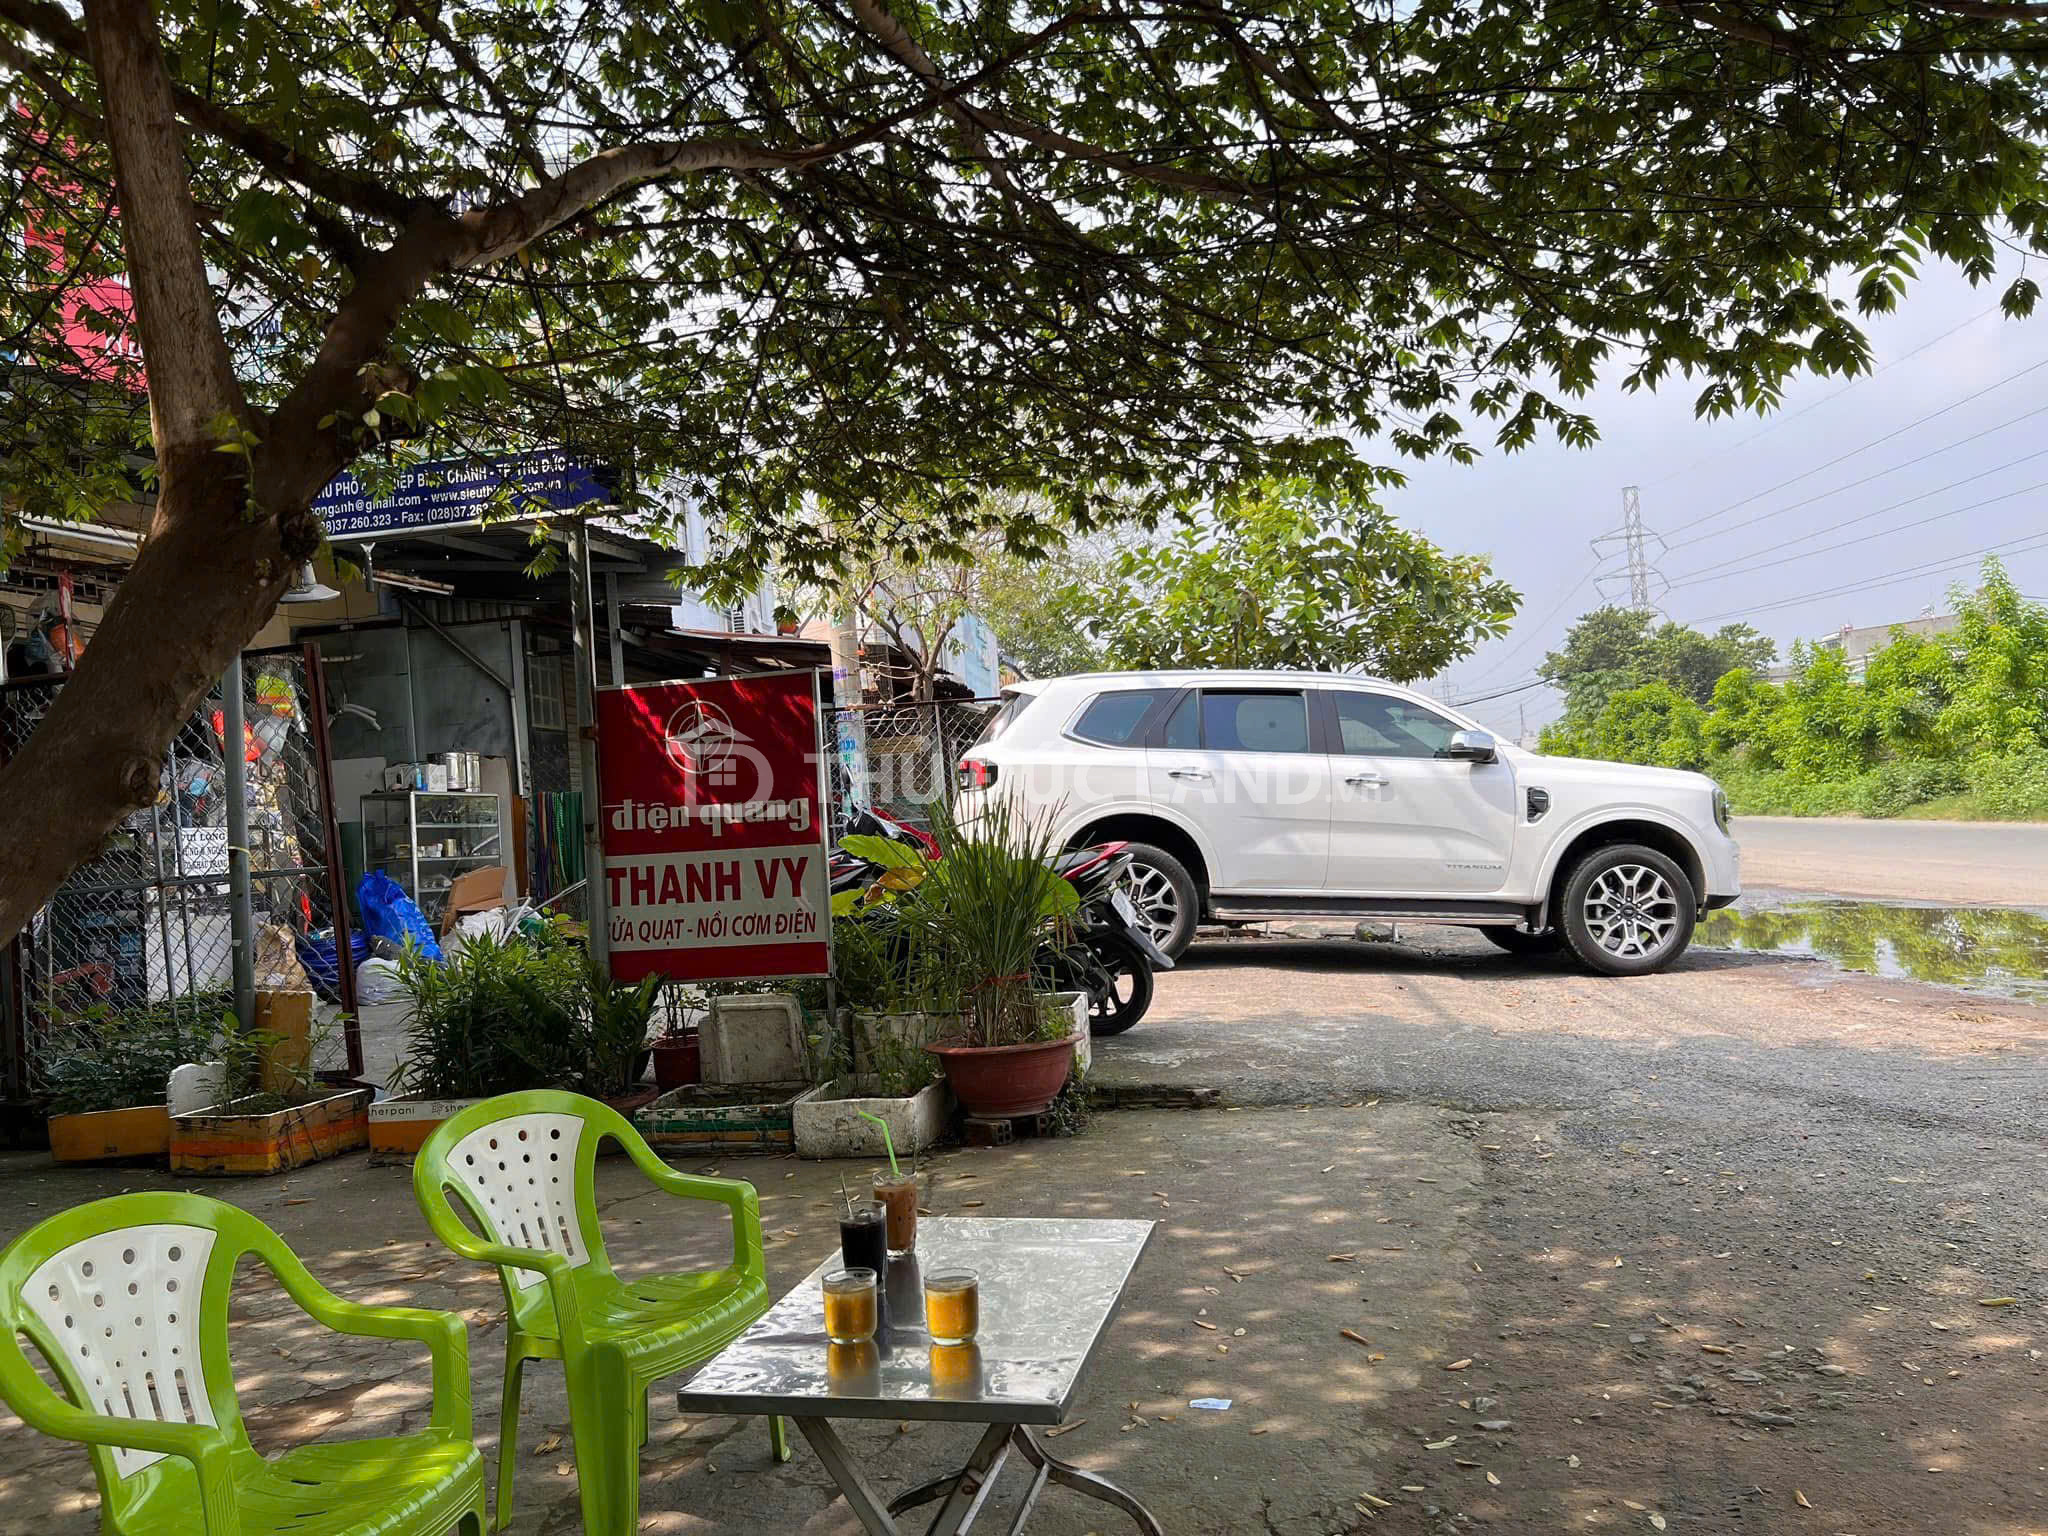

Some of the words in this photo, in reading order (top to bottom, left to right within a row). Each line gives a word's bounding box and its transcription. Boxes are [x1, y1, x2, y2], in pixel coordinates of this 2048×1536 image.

[401, 510, 424, 523] Fax:
[607, 860, 742, 907] THANH
[755, 856, 809, 899] VY
[609, 915, 634, 942] ỬA
[638, 918, 684, 946] QUẠT
[697, 910, 728, 938] NỒI
[732, 913, 771, 936] CƠM
[775, 908, 816, 940] ĐIỆN
